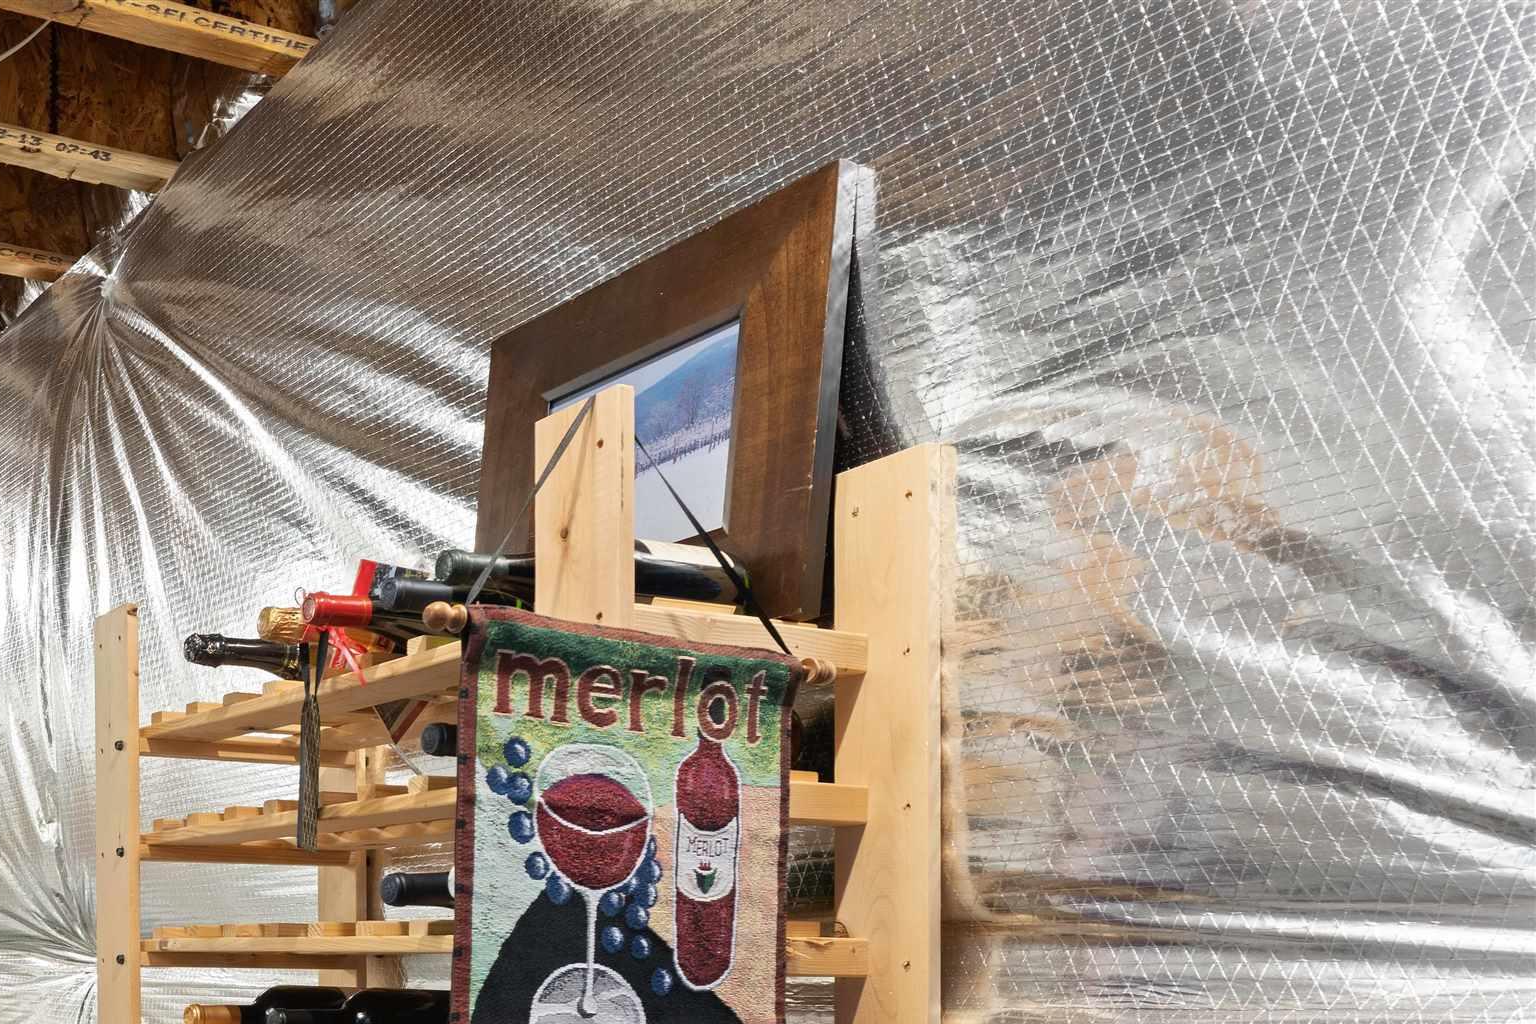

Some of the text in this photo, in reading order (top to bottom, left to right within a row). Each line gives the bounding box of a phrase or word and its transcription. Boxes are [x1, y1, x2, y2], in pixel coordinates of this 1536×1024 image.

[193, 16, 314, 50] CERTIFIE
[492, 648, 769, 745] merlot
[685, 834, 730, 858] MERLOT
